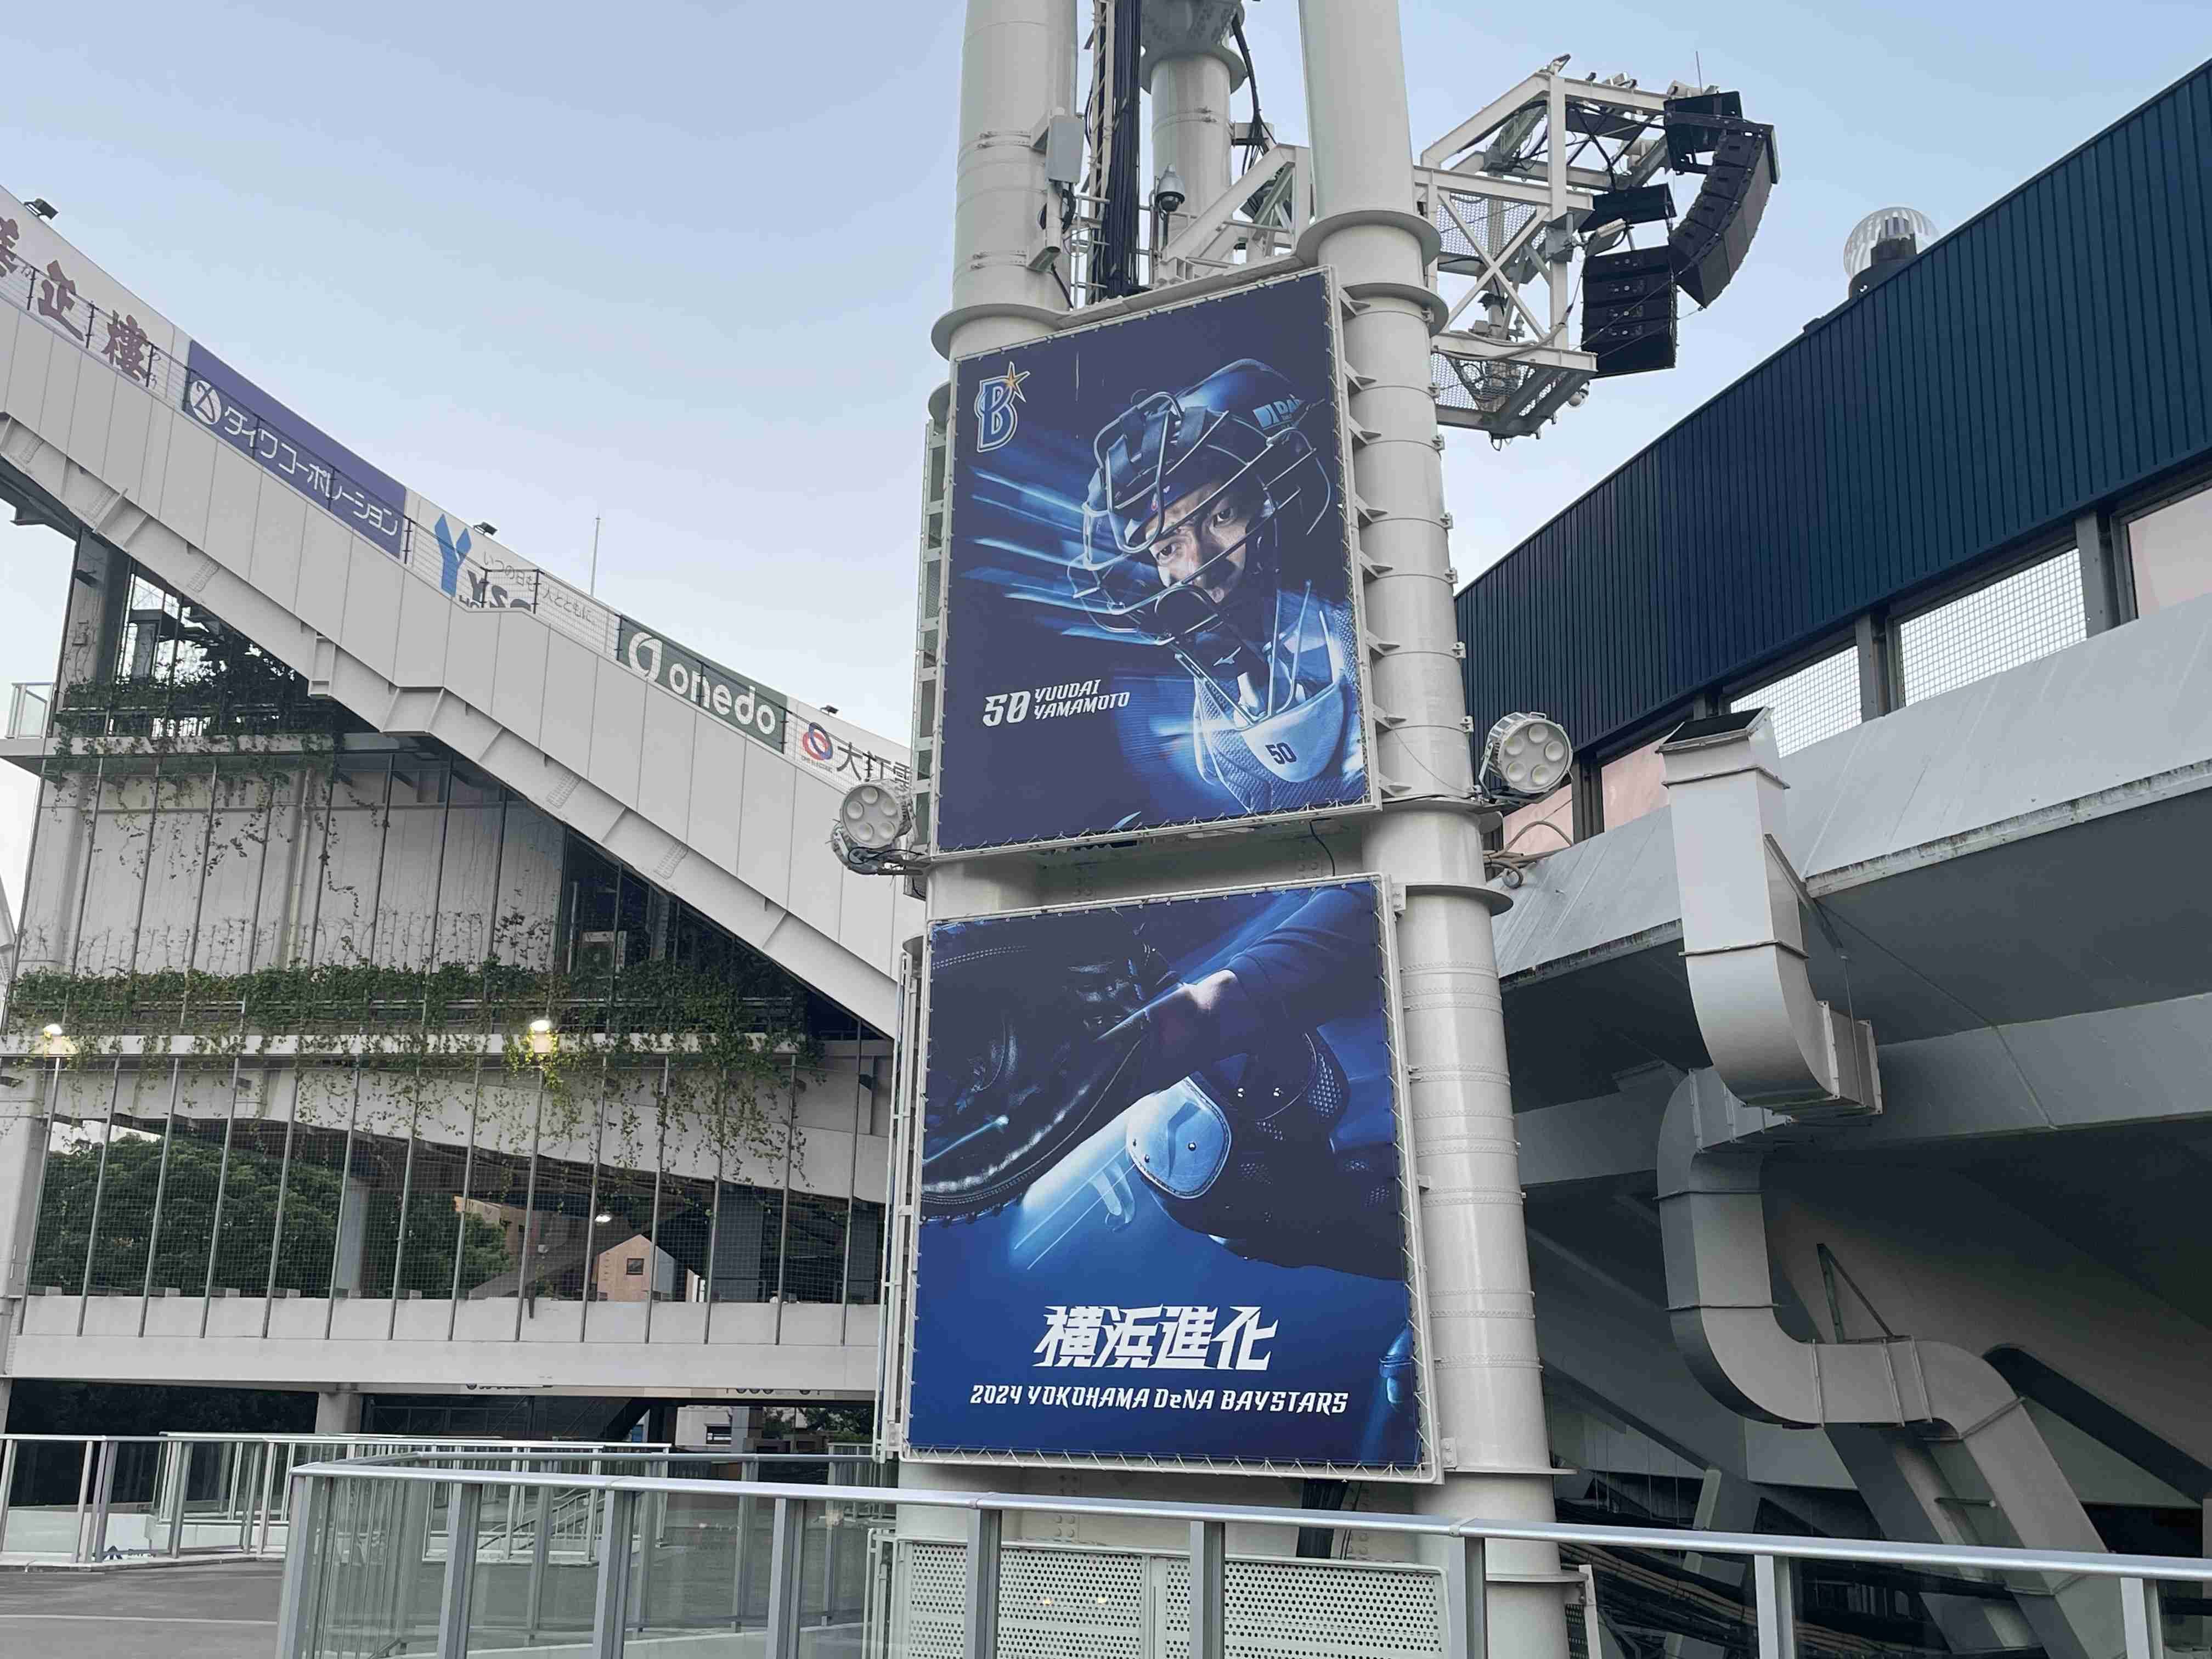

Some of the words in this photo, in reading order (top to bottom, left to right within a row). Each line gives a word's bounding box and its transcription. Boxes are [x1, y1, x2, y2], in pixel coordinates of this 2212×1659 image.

[224, 406, 398, 535] ダイワコーポレーション
[1034, 679, 1101, 703] YUUDAI
[1034, 691, 1130, 720] YAMAMOTO
[983, 691, 1031, 726] 50
[1265, 742, 1296, 764] 50
[1032, 1304, 1279, 1370] 横浜進化
[970, 1385, 1023, 1404] 2024
[1028, 1386, 1150, 1410] YOKOHAMA
[1154, 1389, 1215, 1410] DeNA
[1220, 1390, 1348, 1415] BAYSTARS
